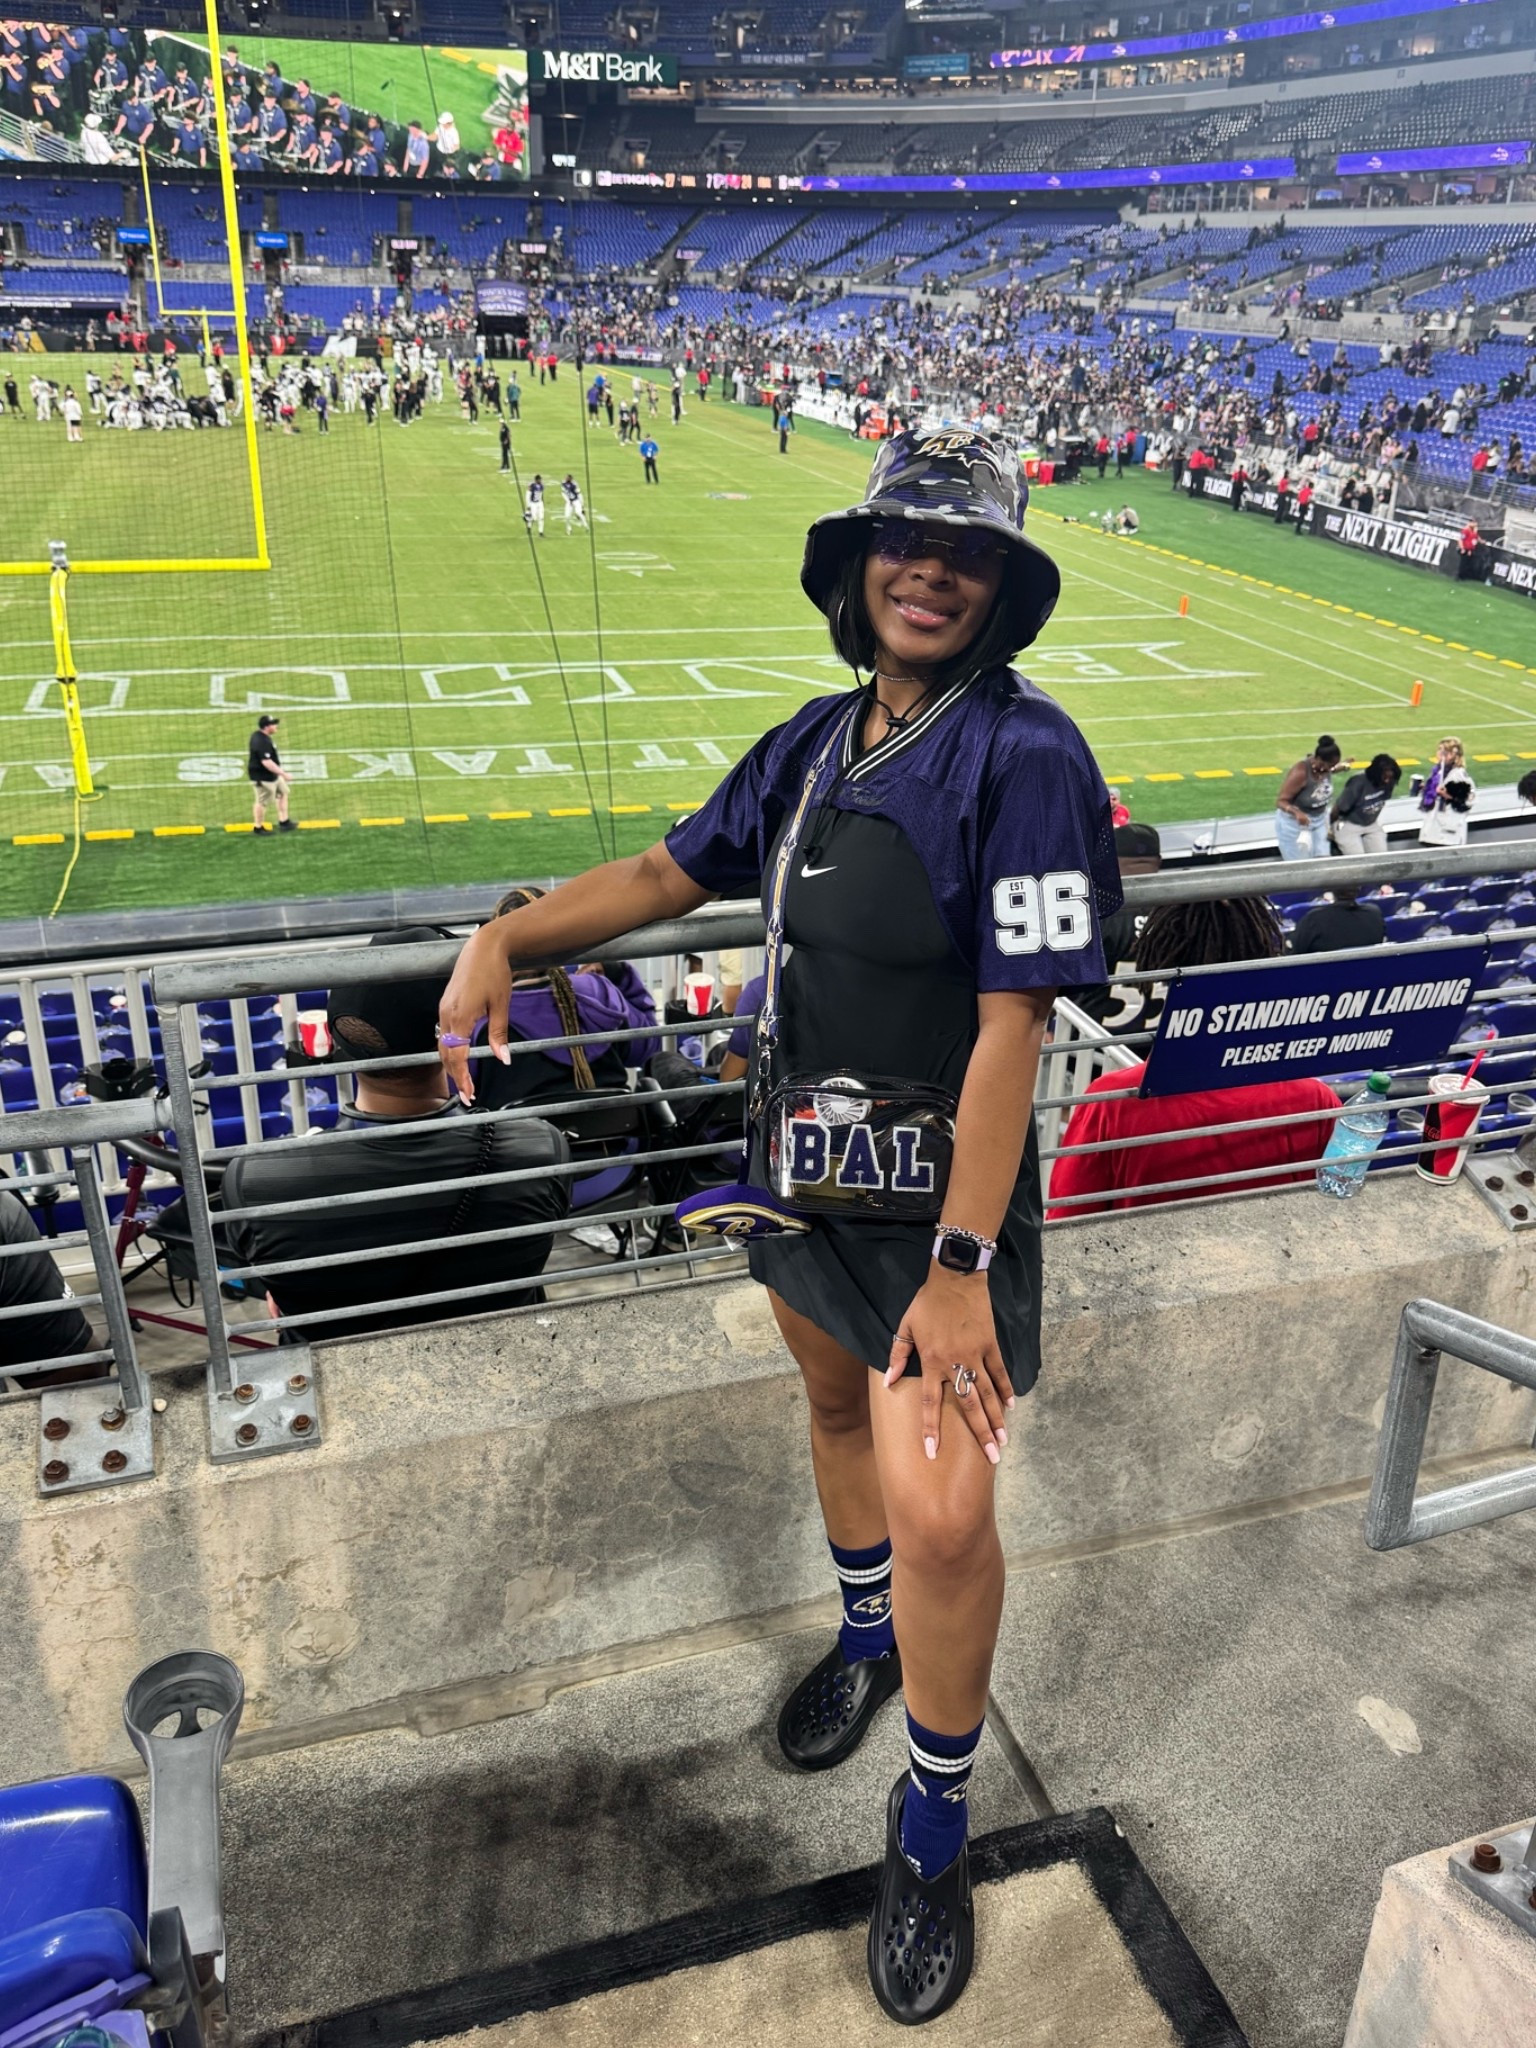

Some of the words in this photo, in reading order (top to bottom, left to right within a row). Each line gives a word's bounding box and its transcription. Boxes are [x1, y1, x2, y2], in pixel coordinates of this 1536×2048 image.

[543, 50, 604, 80] M&T
[605, 53, 663, 82] Bank
[1325, 515, 1342, 532] THE
[1340, 513, 1383, 547] NEXT
[1381, 524, 1450, 566] FLIGHT
[1506, 562, 1536, 591] NEX
[1010, 881, 1024, 891] EST
[992, 870, 1092, 956] 96
[1165, 1008, 1204, 1039] NO
[1207, 994, 1331, 1035] STANDING
[1332, 990, 1367, 1020] ON
[1369, 978, 1471, 1016] LANDING
[1221, 1042, 1284, 1068] PLEASE
[1285, 1037, 1328, 1059] KEEP
[1327, 1028, 1393, 1054] MOVING
[787, 1117, 935, 1192] BAL
